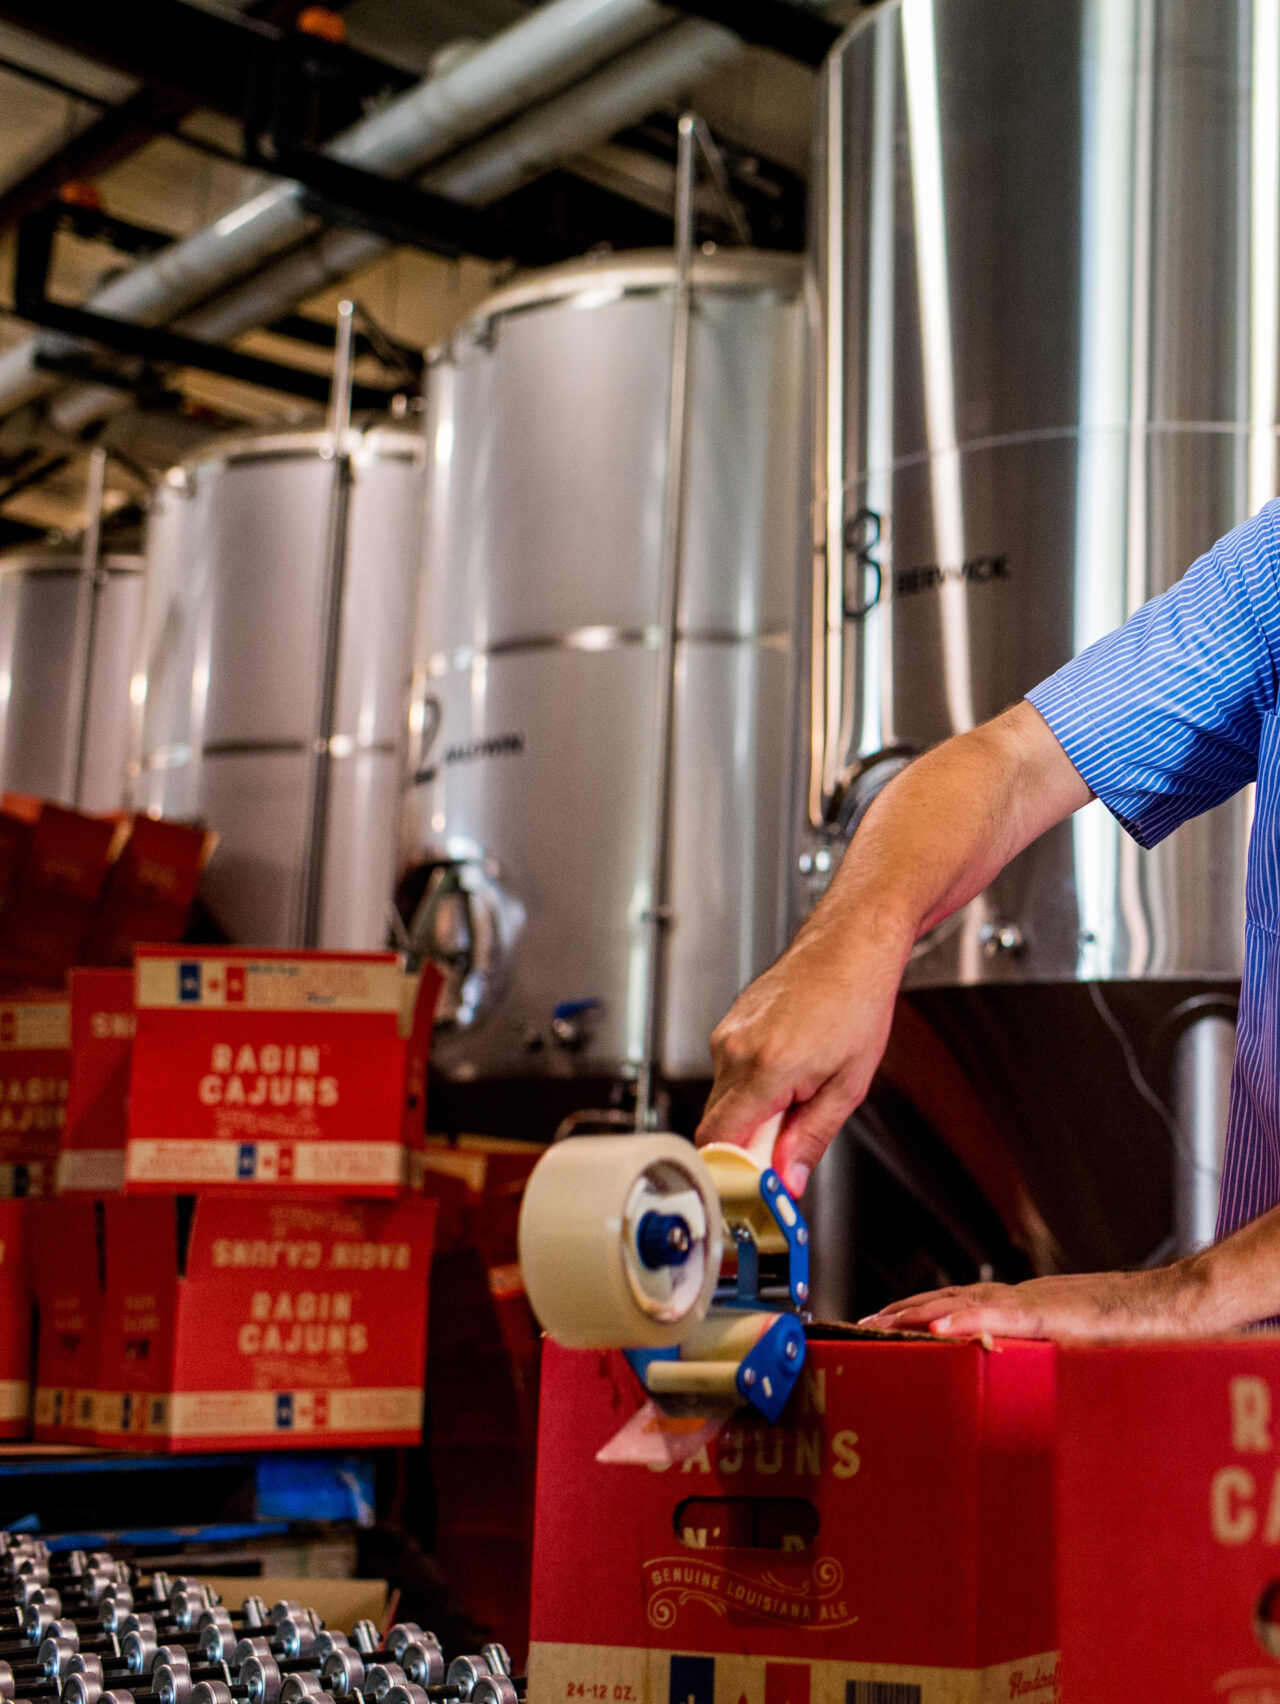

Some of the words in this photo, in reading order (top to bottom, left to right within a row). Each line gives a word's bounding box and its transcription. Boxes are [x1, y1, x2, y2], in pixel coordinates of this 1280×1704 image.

[199, 1075, 339, 1106] CAJUNS
[238, 1323, 368, 1355] CAJUNS
[651, 1567, 721, 1590] GENUINE
[727, 1581, 811, 1618] LOUISIANA
[819, 1601, 848, 1620] ALE
[565, 1682, 607, 1698] 24-12
[613, 1684, 637, 1702] OZ.
